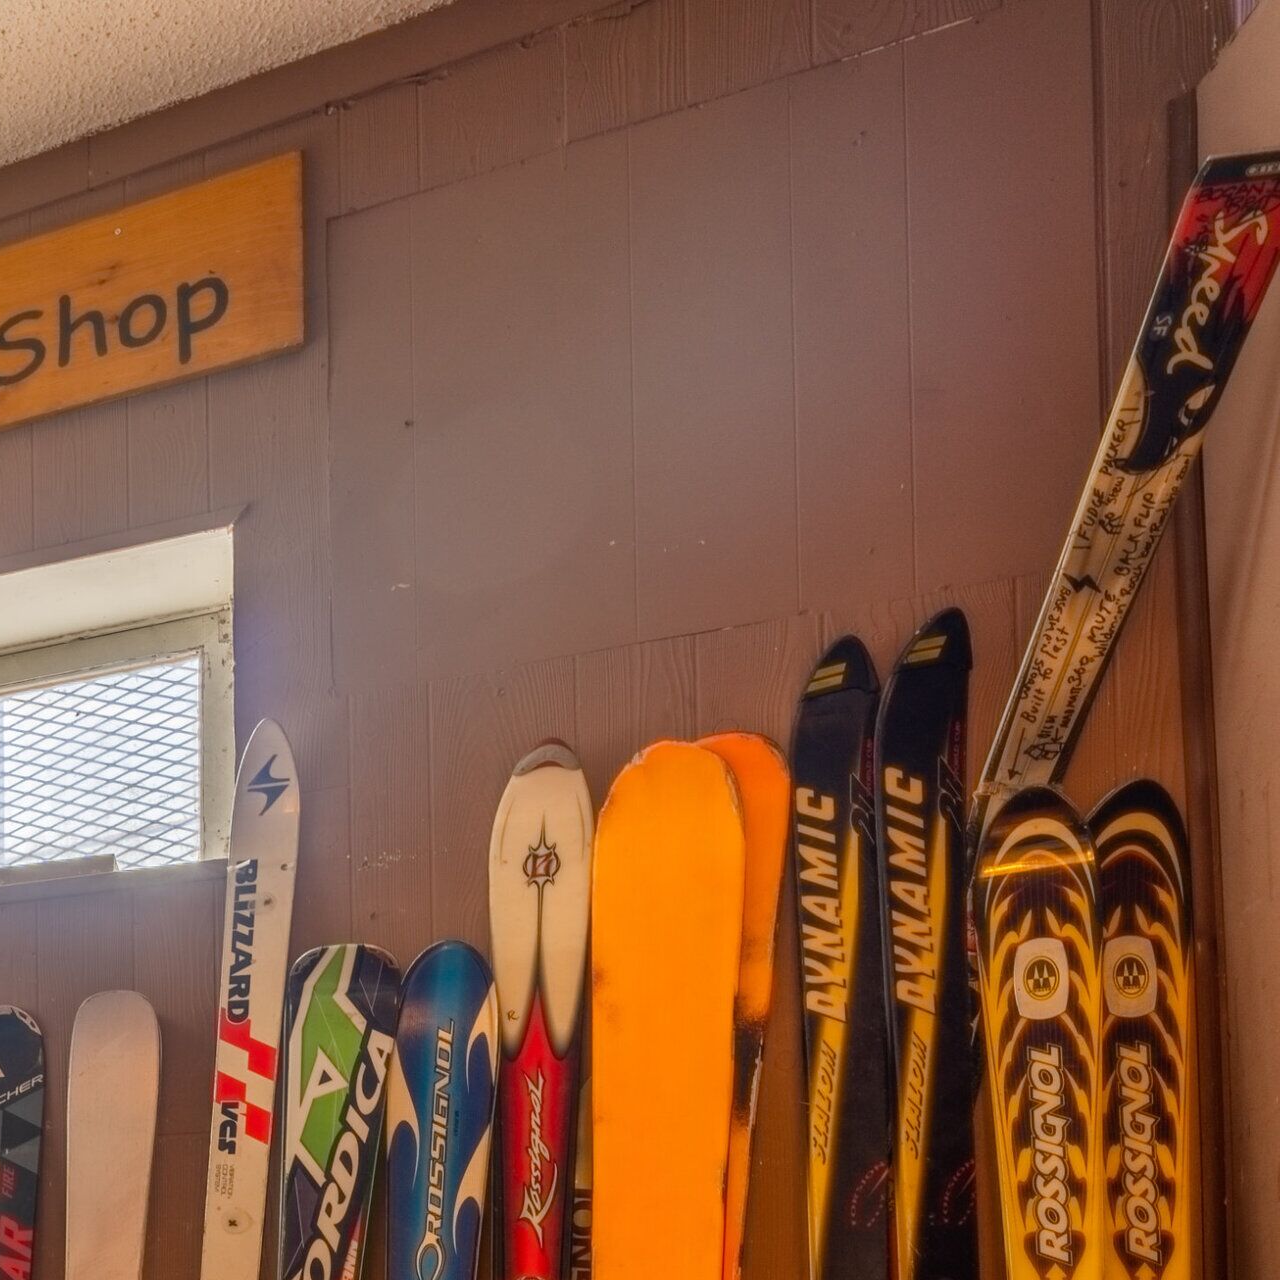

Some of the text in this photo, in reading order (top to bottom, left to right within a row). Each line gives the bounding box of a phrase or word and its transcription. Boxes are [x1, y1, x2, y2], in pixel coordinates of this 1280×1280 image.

[1165, 208, 1269, 375] Speed
[1078, 488, 1106, 542] FUDGE
[1020, 626, 1070, 724] Built to last
[226, 858, 258, 1024] BLIZZARD
[795, 786, 847, 1025] DYNAMIC
[884, 766, 937, 1017] DYNAMIC
[1, 1166, 16, 1199] FIRE
[424, 1016, 456, 1240] ROSSIGNOL
[517, 1067, 559, 1250] Rossignol
[1026, 1040, 1075, 1268] ROSSIGNOL
[1115, 1040, 1163, 1268] ROSSIGNOL
